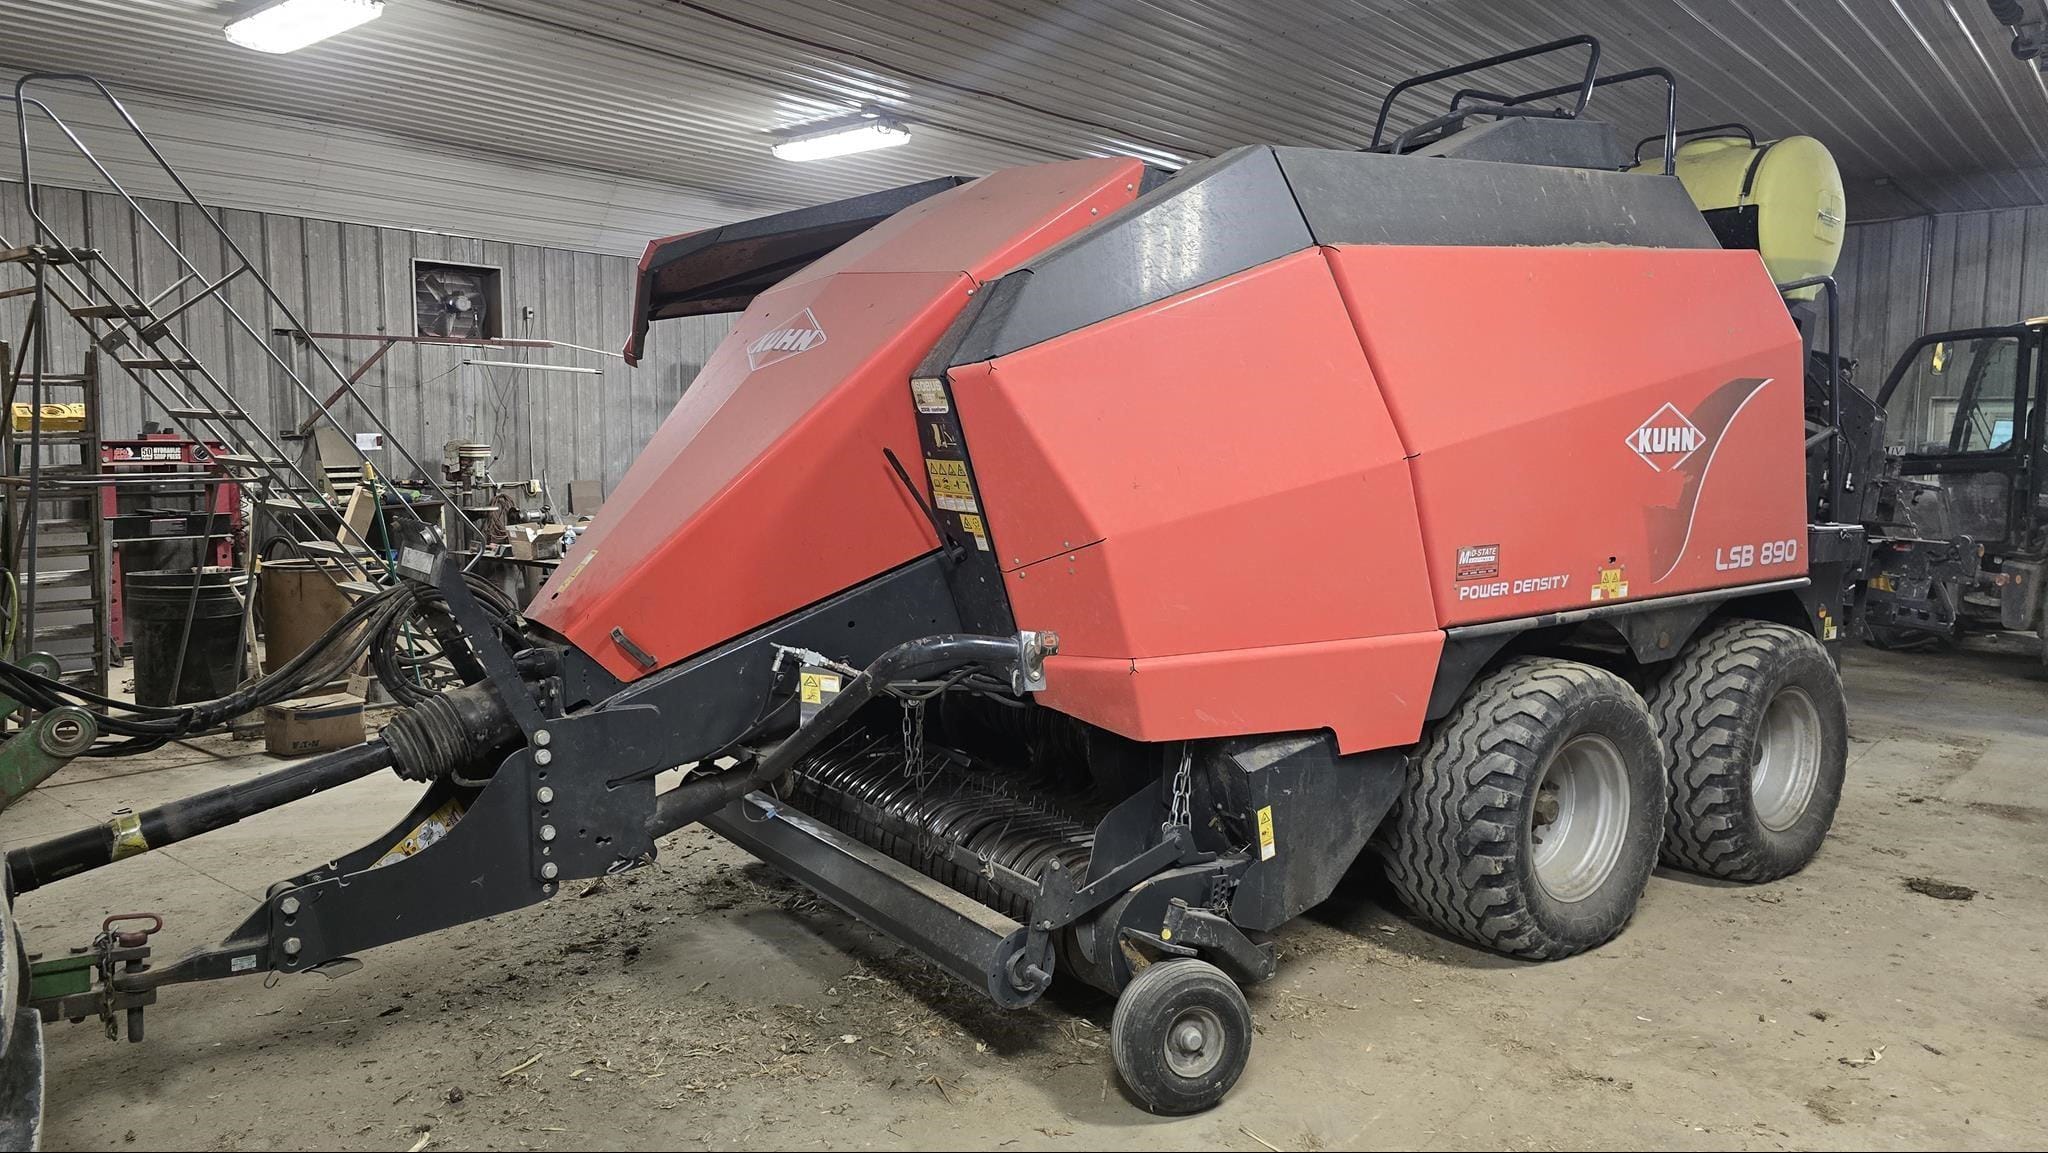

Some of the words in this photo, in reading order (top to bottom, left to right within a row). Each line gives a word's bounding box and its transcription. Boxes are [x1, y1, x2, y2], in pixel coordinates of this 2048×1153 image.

[750, 328, 821, 354] KUHN
[142, 447, 152, 456] 50
[1638, 427, 1695, 453] KUHN
[1715, 544, 1754, 571] LSB
[1760, 539, 1797, 565] 890
[1459, 582, 1509, 600] POWER
[1513, 574, 1569, 594] DENSITY
